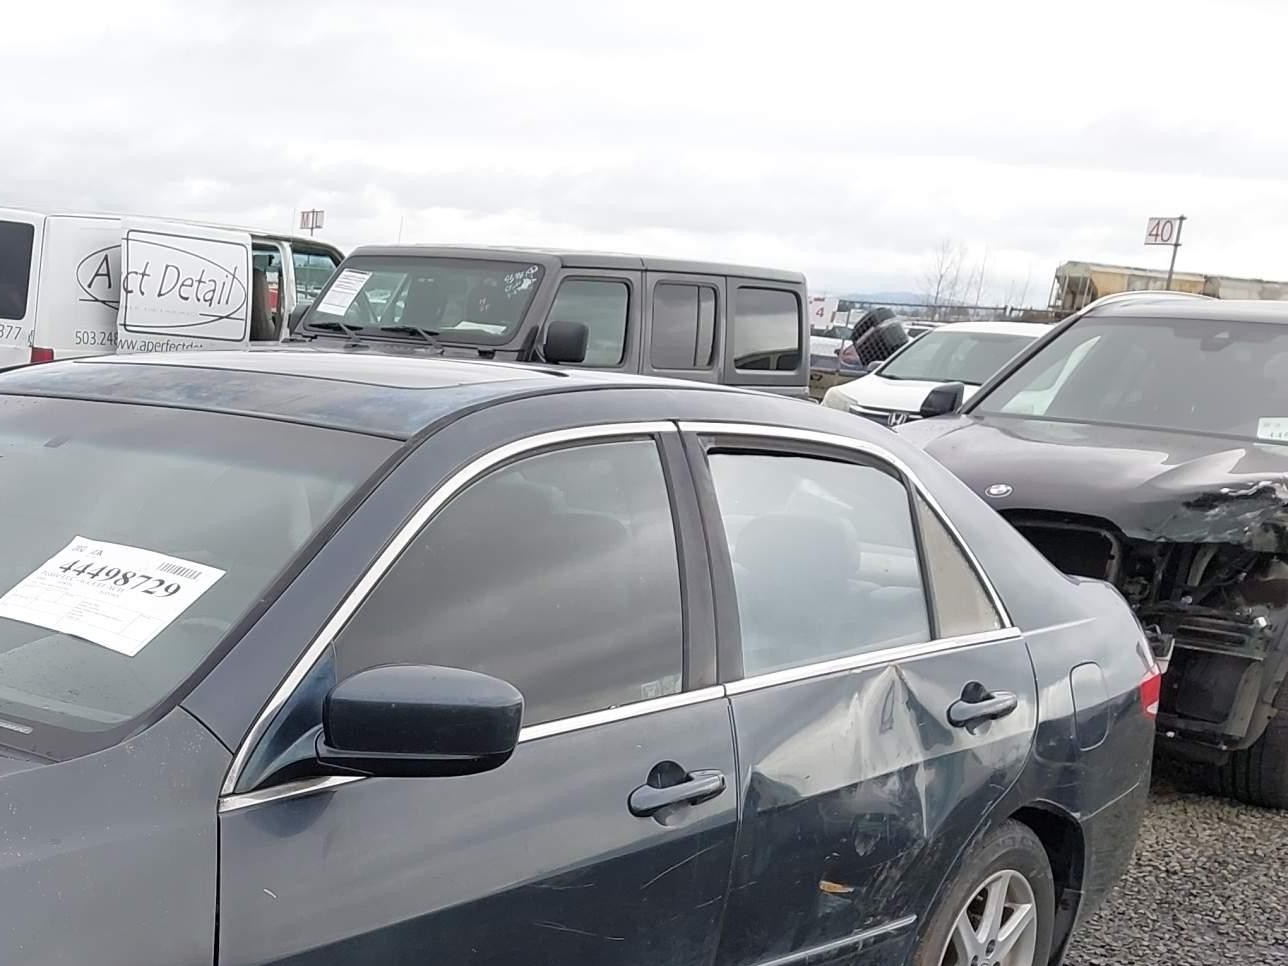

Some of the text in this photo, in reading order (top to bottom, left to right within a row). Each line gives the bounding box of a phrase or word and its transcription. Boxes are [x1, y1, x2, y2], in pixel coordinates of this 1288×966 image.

[1148, 219, 1174, 242] 40
[87, 253, 112, 289] A
[157, 263, 238, 307] Detail
[58, 559, 181, 598] 44498729
